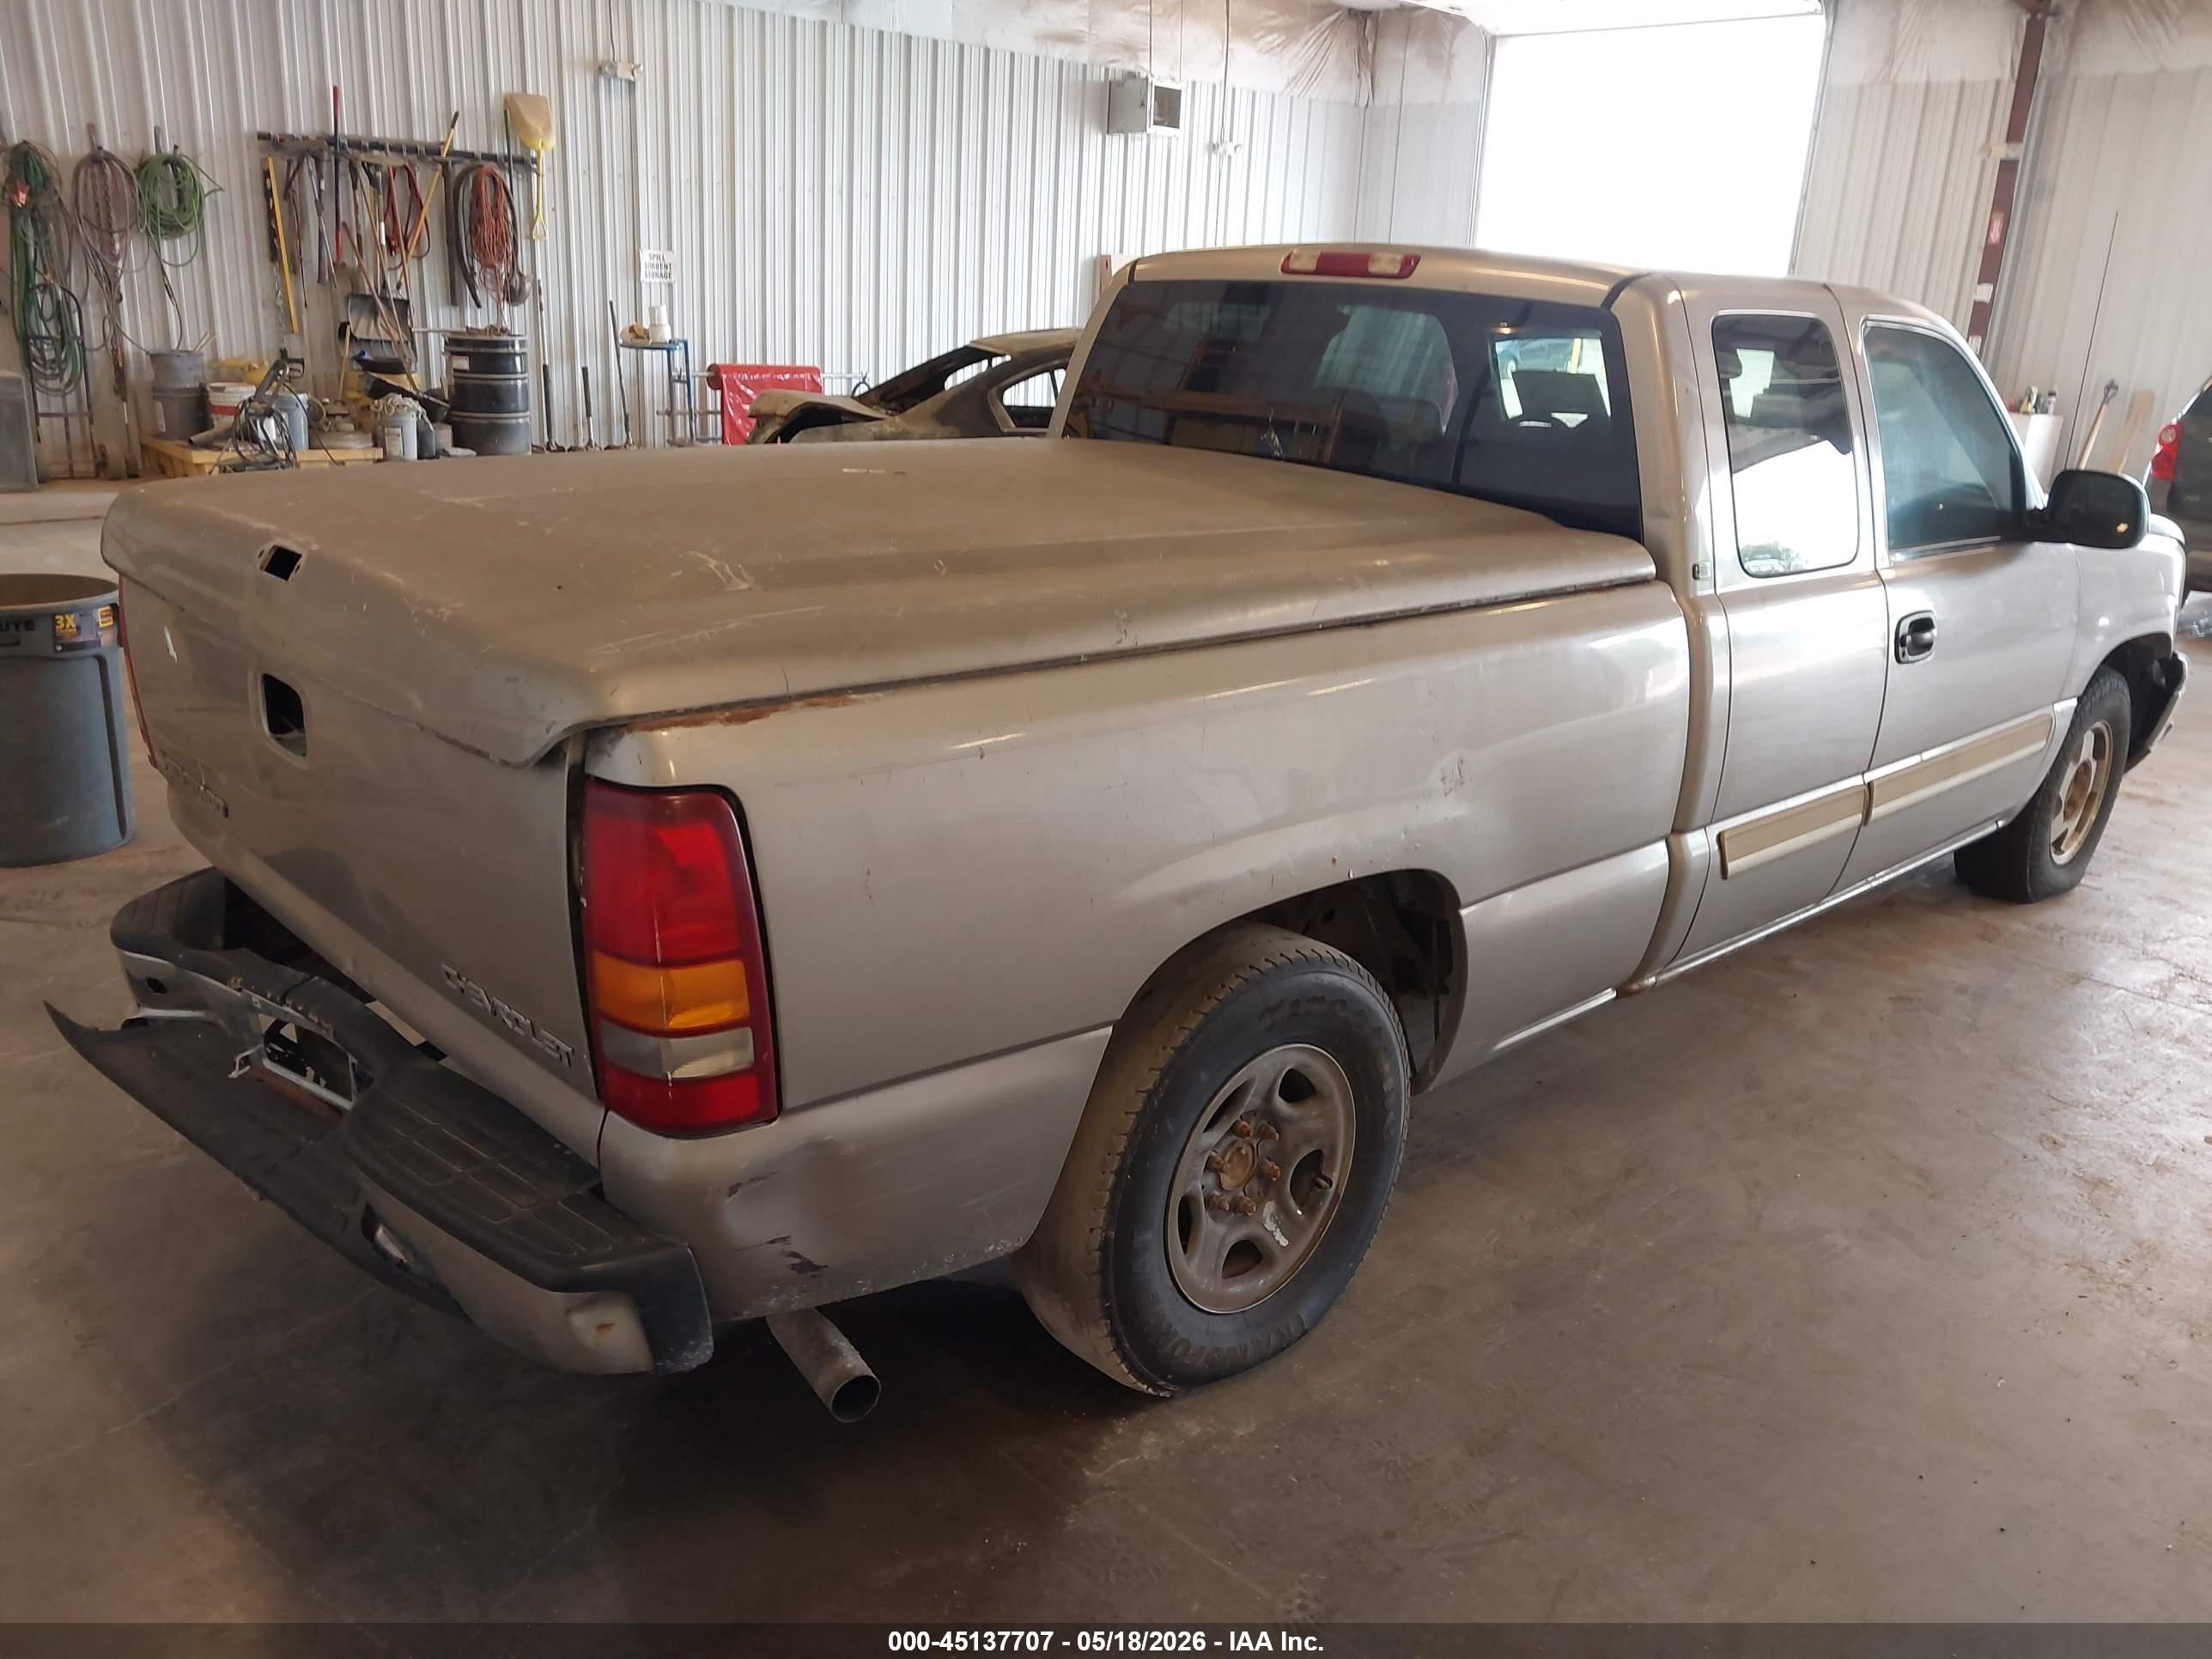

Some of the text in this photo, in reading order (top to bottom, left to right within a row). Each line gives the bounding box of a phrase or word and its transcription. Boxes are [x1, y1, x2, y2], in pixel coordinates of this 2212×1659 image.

[648, 252, 665, 261] SPILL
[644, 271, 672, 280] STORAGE
[55, 614, 76, 632] 3X
